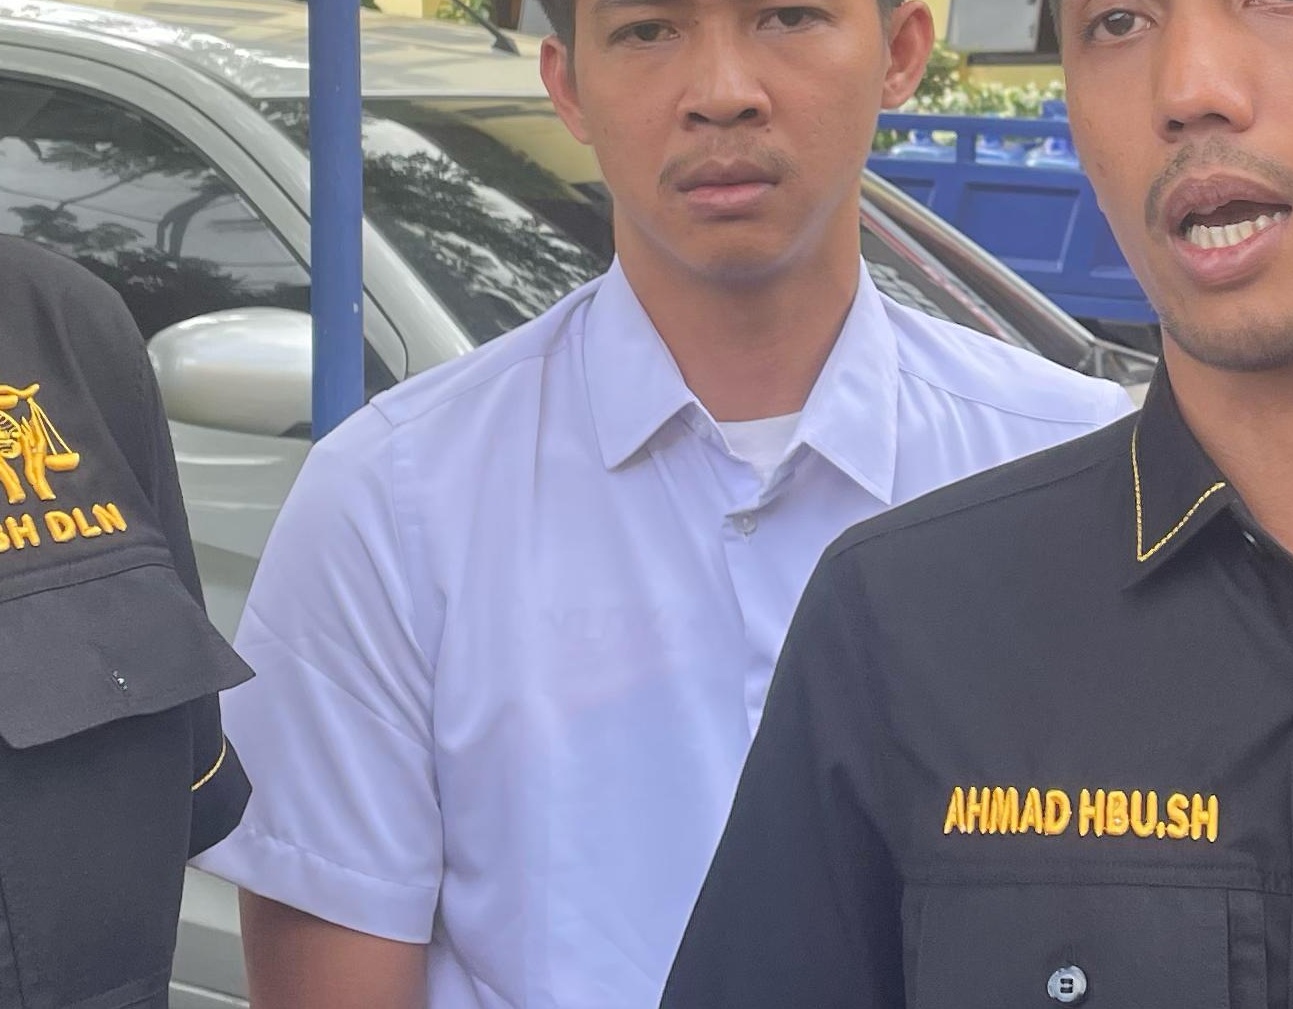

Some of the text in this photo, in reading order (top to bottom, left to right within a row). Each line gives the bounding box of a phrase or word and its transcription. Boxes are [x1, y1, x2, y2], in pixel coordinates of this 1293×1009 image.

[44, 502, 127, 543] DLN
[943, 786, 1219, 842] AHMAD HBU.SH
